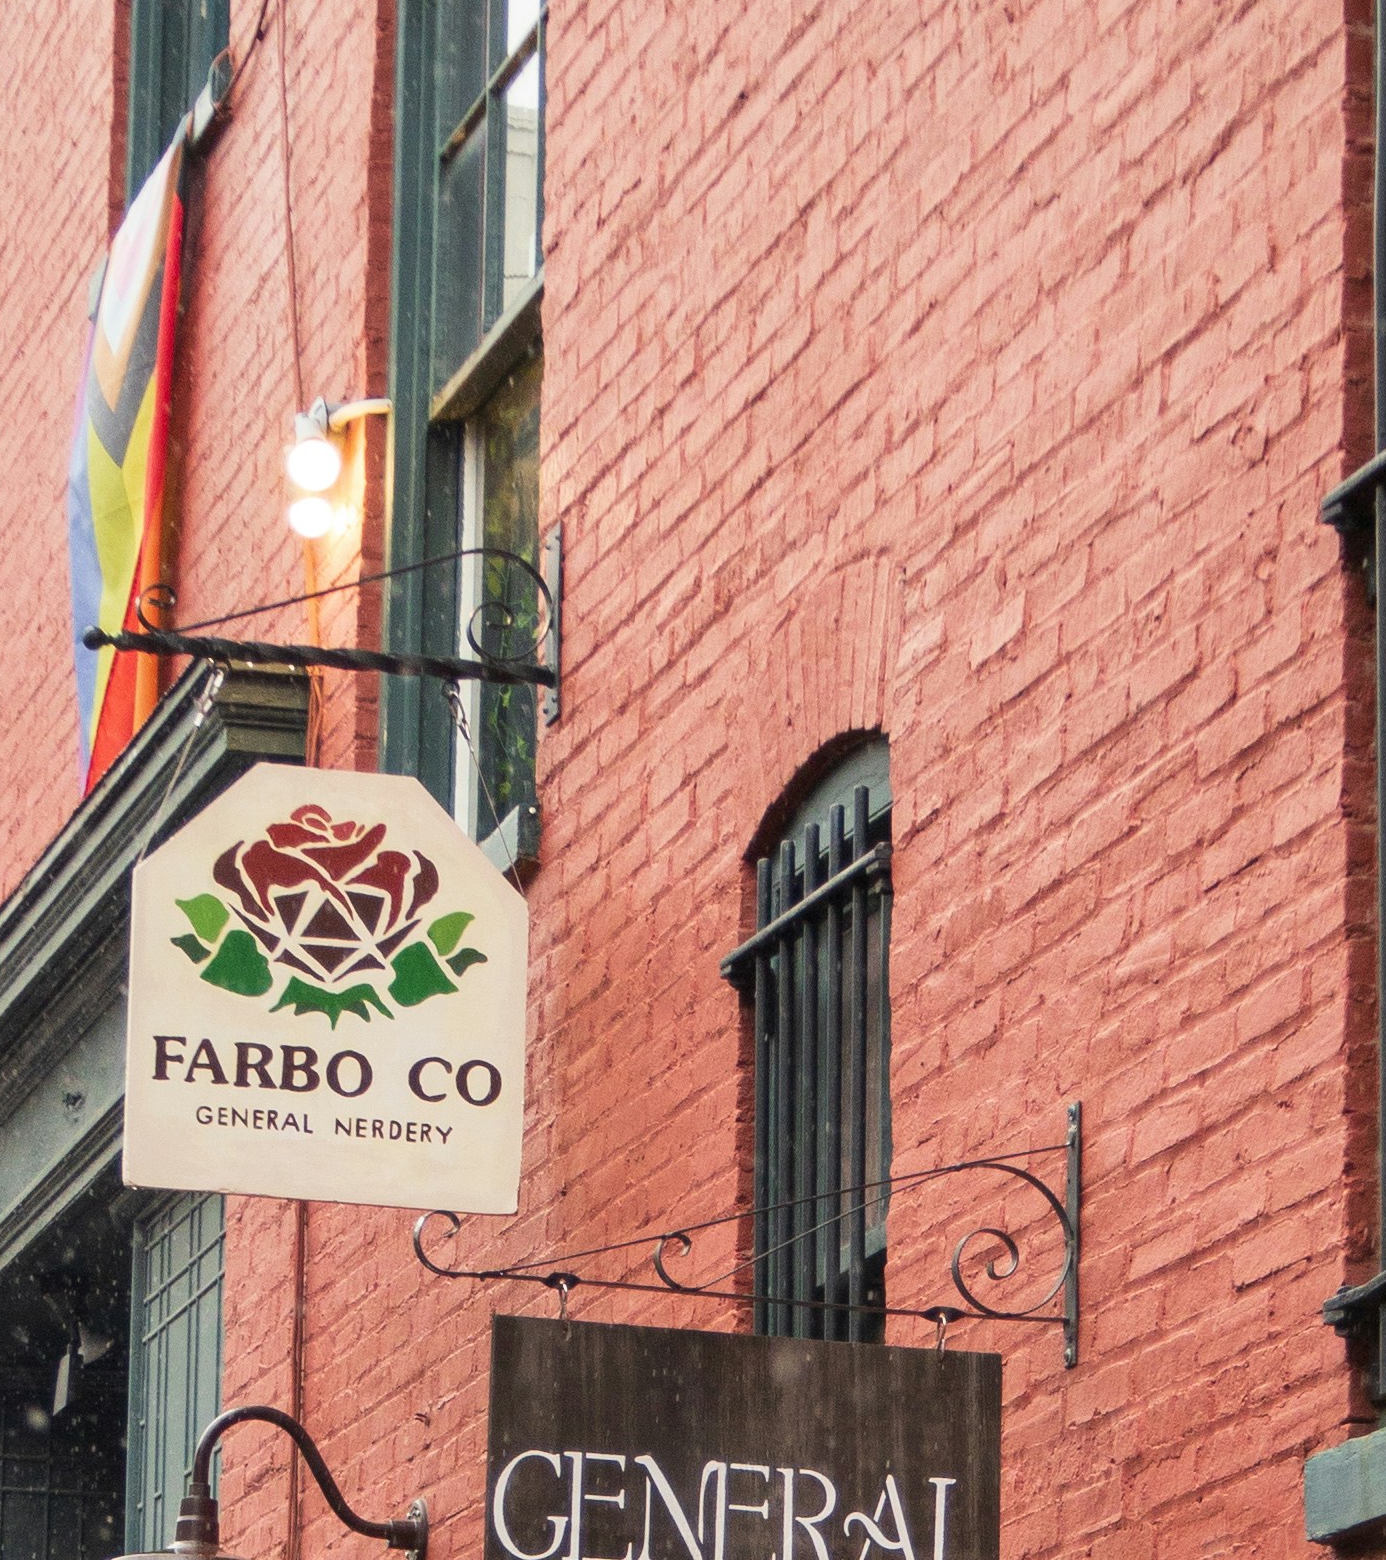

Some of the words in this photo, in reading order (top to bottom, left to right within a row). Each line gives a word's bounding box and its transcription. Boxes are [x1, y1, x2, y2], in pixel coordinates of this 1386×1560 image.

[152, 1034, 374, 1098] FARBO
[408, 1056, 503, 1107] CO
[195, 1105, 314, 1135] GENERAL
[334, 1117, 454, 1145] NERDERY
